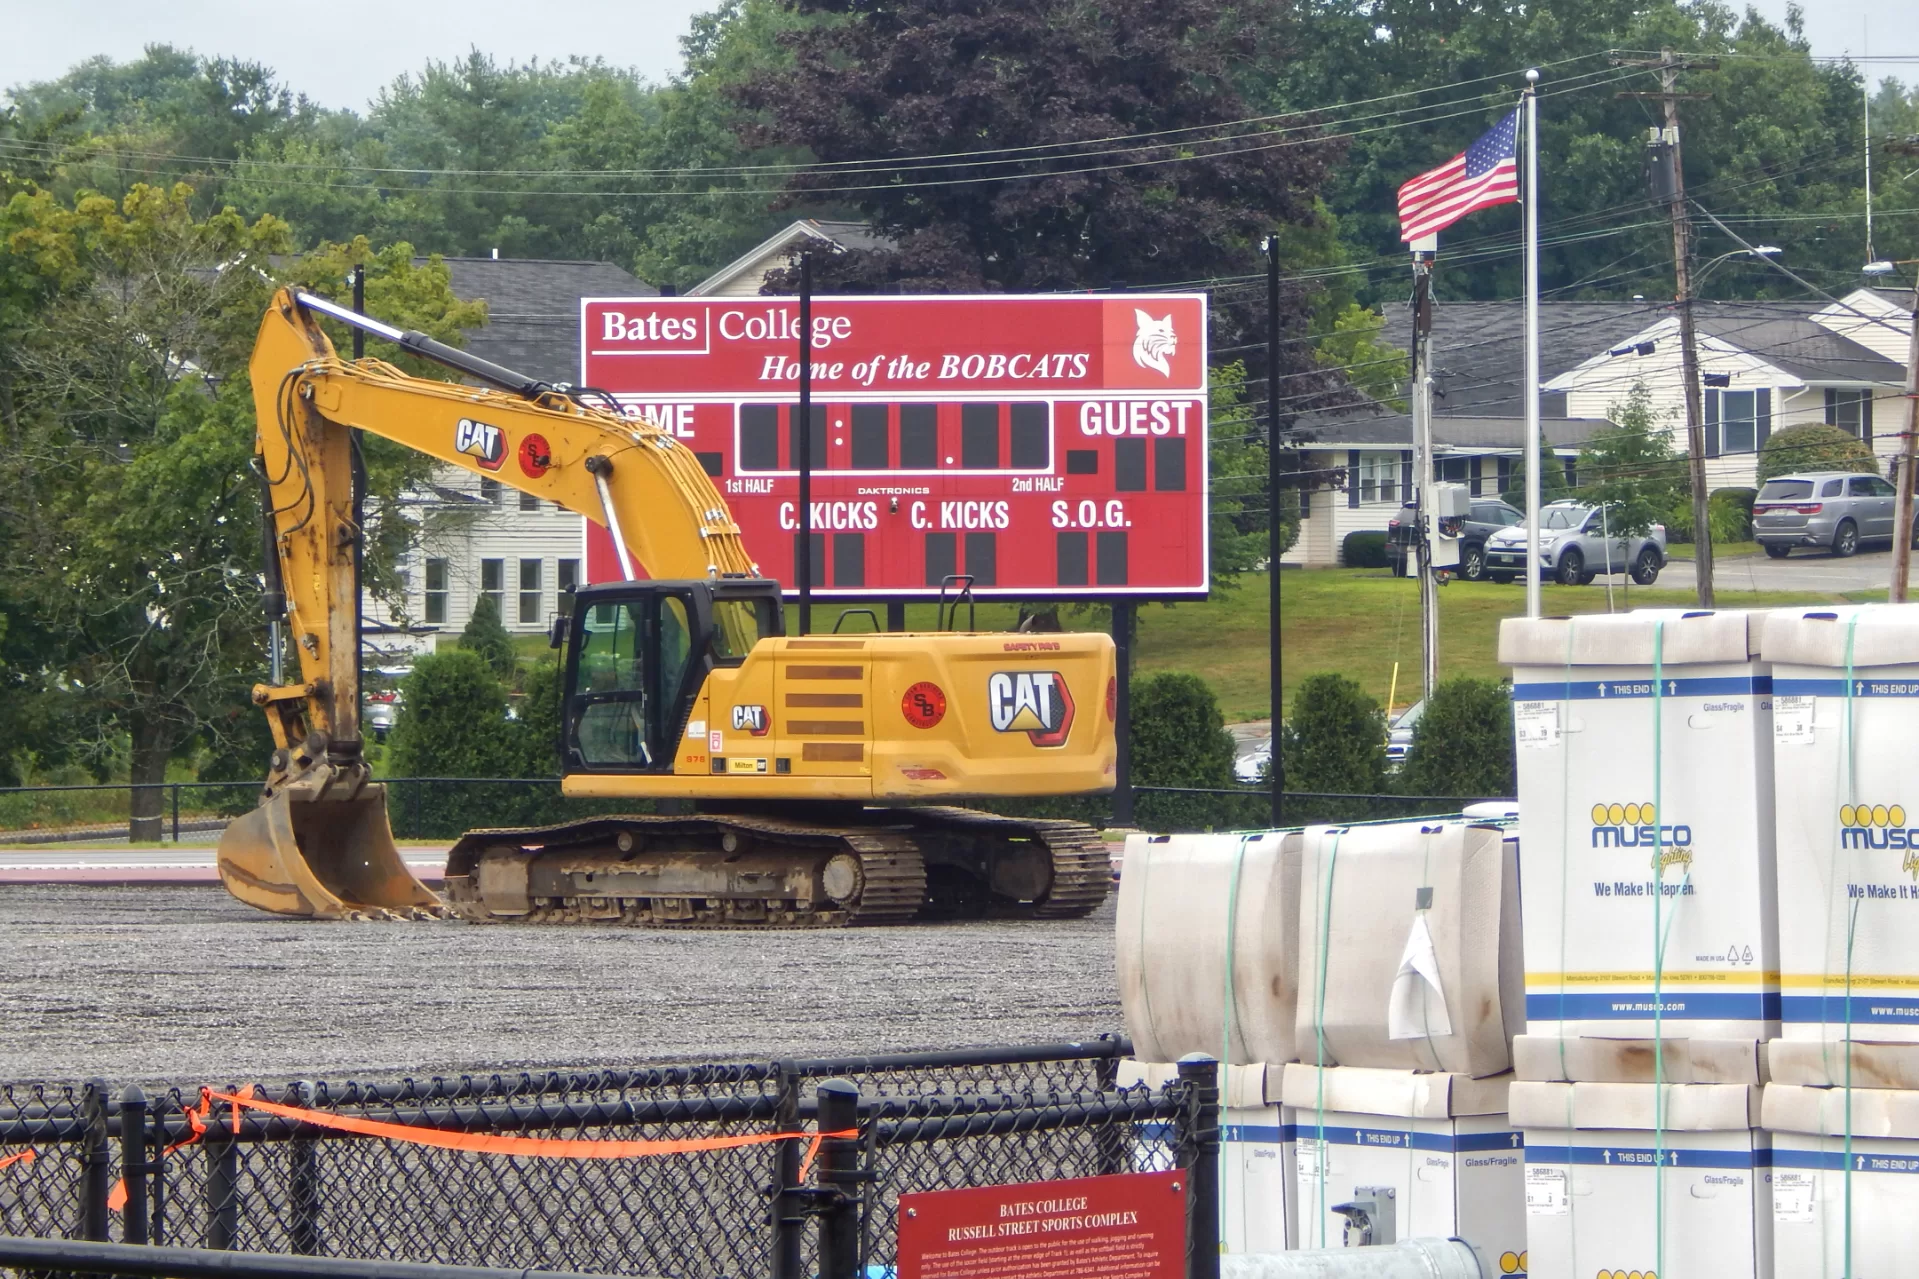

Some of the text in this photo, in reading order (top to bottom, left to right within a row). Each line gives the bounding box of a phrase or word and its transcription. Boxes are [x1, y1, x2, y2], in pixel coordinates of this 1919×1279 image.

[602, 311, 697, 341] Bates
[719, 308, 852, 348] College
[758, 353, 1090, 386] Home of the BOBCATS
[594, 404, 695, 438] ME
[1080, 400, 1192, 436] GUEST
[456, 418, 499, 461] CAT
[725, 478, 774, 494] 1st HALF
[857, 487, 930, 495] DAKTRONICS
[1012, 476, 1064, 492] 2nd HALF
[779, 501, 877, 529] C. KICKS
[911, 501, 1009, 529] C. KICKS
[1052, 500, 1131, 528] S.O.G.
[1613, 684, 1631, 695] THIS
[1633, 684, 1649, 694] END
[1871, 684, 1919, 694] THIS END UP
[990, 673, 1054, 731] CAT
[1703, 702, 1744, 713] Glass/Fragile
[733, 705, 762, 730] CAT
[1594, 882, 1611, 897] We
[1614, 881, 1643, 897] Make
[1646, 882, 1655, 896] It
[1847, 884, 1864, 898] We
[1867, 884, 1897, 899] Make
[1900, 885, 1908, 899] It
[1366, 1133, 1400, 1145] THIS END UP
[1465, 1157, 1517, 1168] Glass/Fragile
[1617, 1152, 1635, 1162] THIS
[1637, 1153, 1652, 1163] END
[1871, 1158, 1919, 1170] THIS END UP
[1704, 1175, 1744, 1187] Glass/Fragile
[1000, 1197, 1088, 1218] BATES COLLEGE
[948, 1212, 1138, 1241] RUSSELL STREET SPORTS COMPLEX
